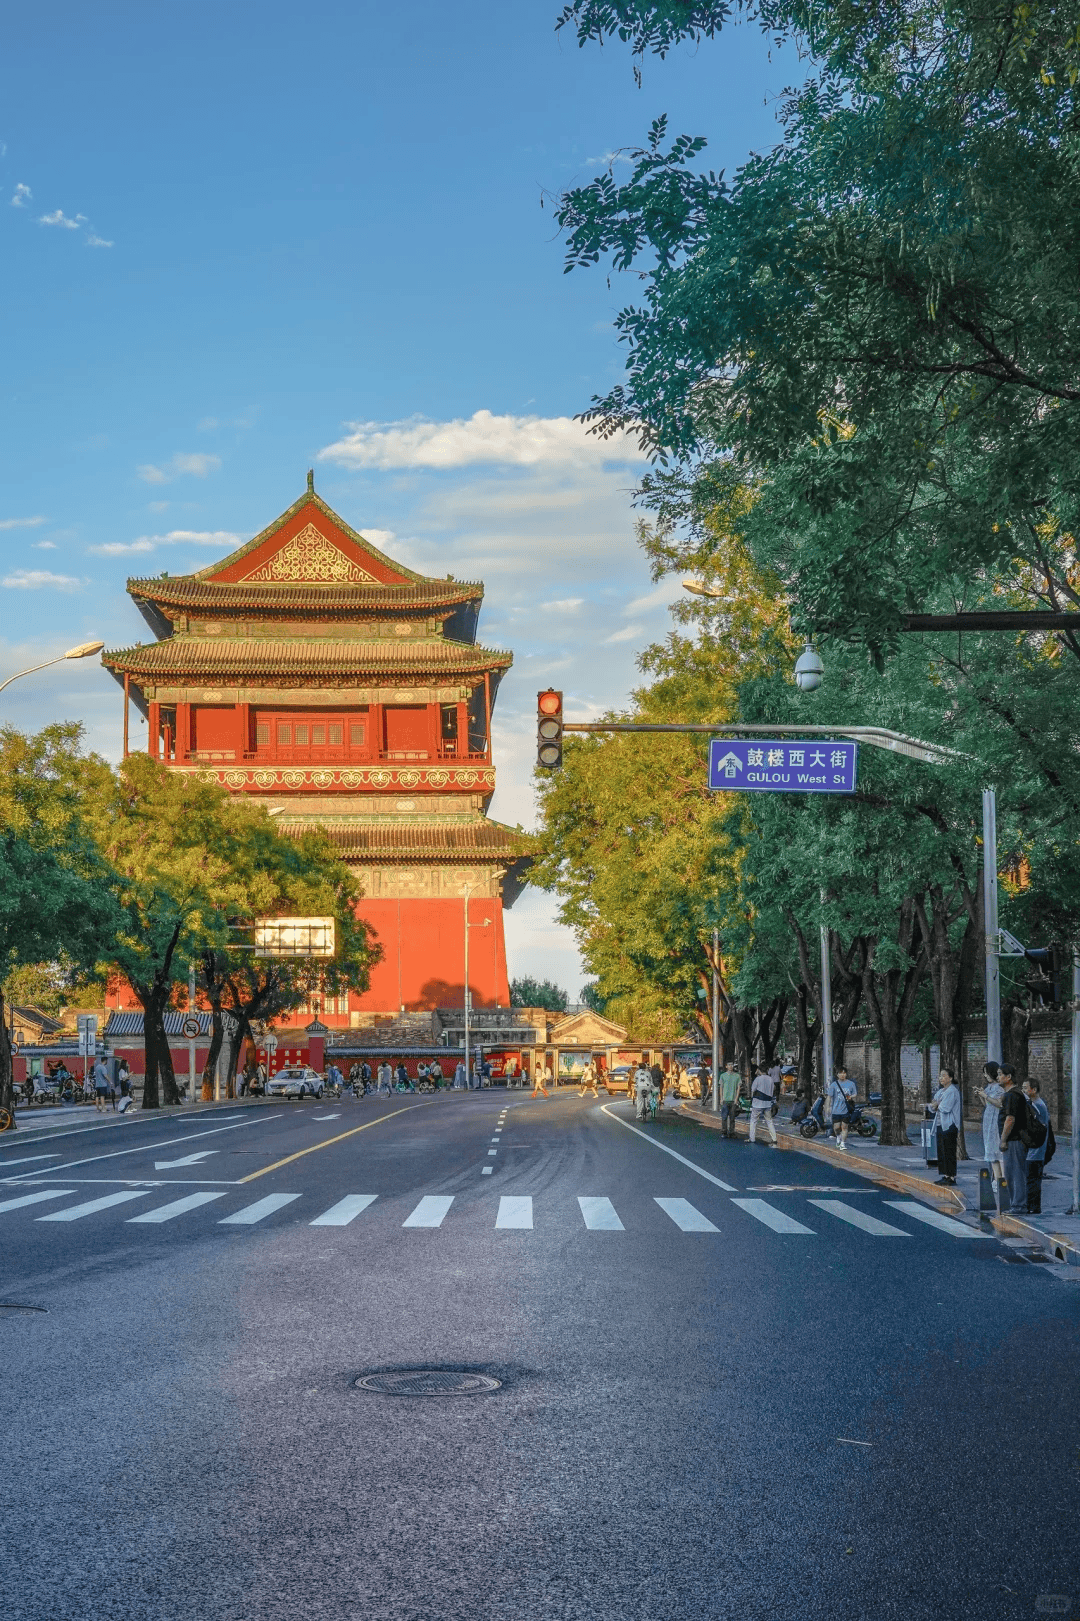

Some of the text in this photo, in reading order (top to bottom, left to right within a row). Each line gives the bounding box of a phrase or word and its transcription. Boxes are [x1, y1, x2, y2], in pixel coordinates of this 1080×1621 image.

[725, 758, 735, 768] 东
[747, 748, 847, 768] 鼓楼西大街
[747, 772, 846, 784] GULOU West St
